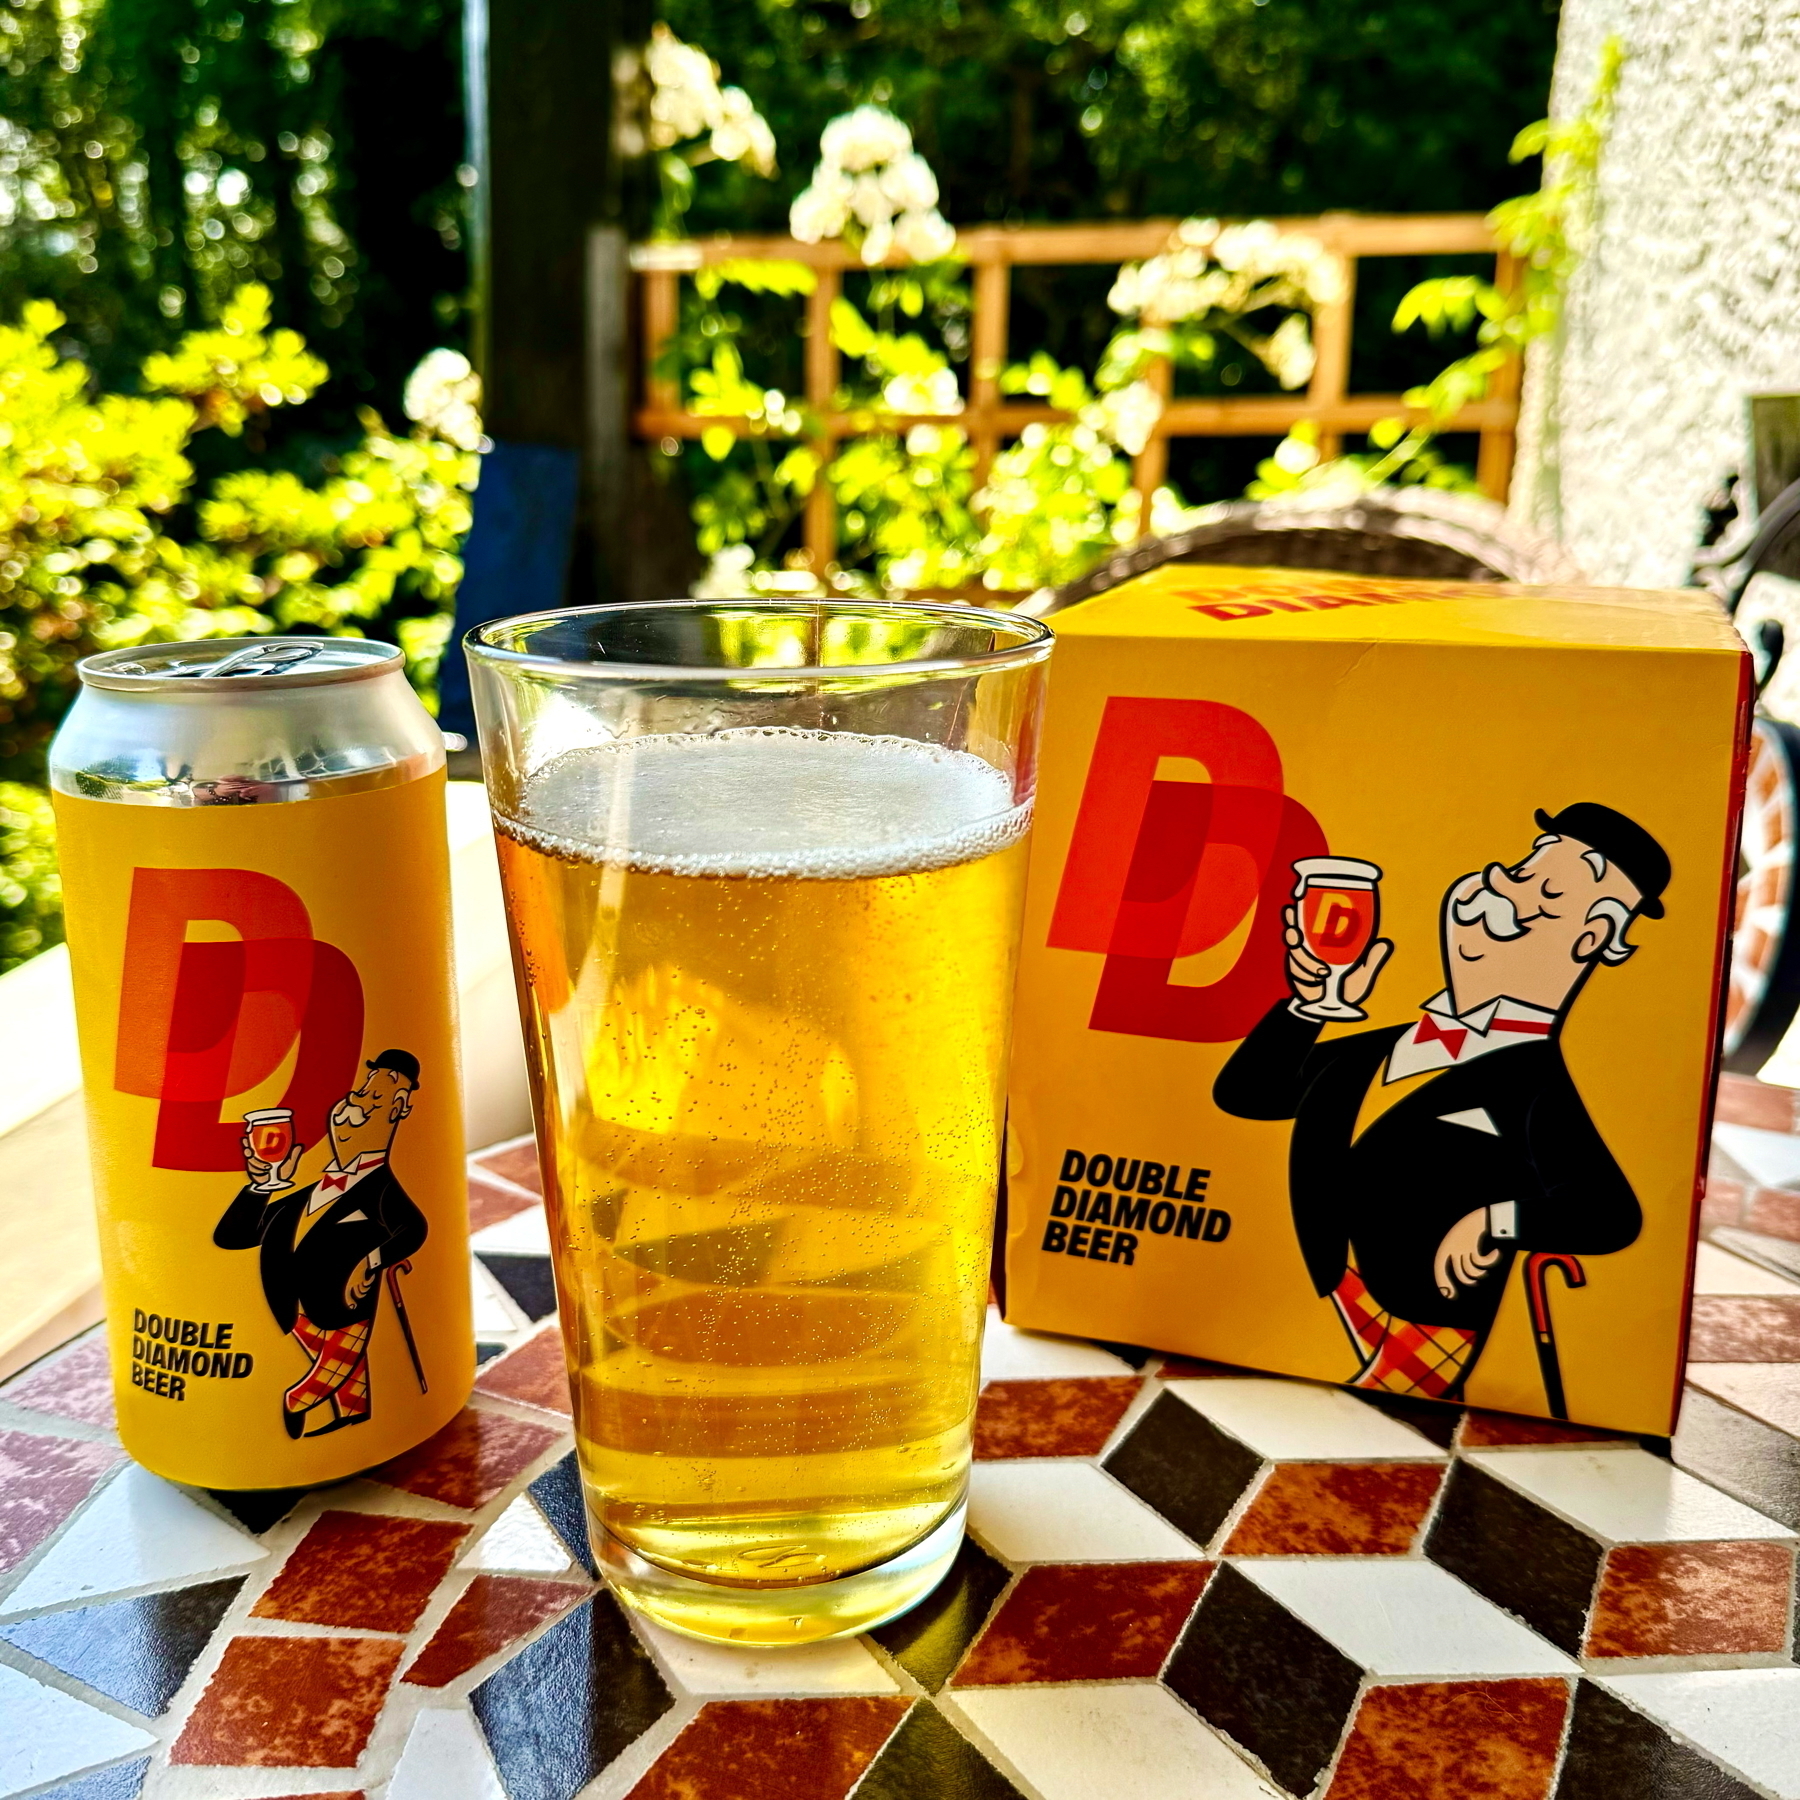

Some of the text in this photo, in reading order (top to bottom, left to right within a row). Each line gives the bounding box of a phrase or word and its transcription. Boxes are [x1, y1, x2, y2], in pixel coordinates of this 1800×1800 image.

[1059, 1149, 1211, 1203] DOUBLE
[1050, 1185, 1231, 1243] DIAMOND
[1041, 1220, 1138, 1266] BEER
[134, 1307, 234, 1349] DOUBLE
[132, 1334, 254, 1378] DIAMOND
[131, 1360, 186, 1401] BEER
